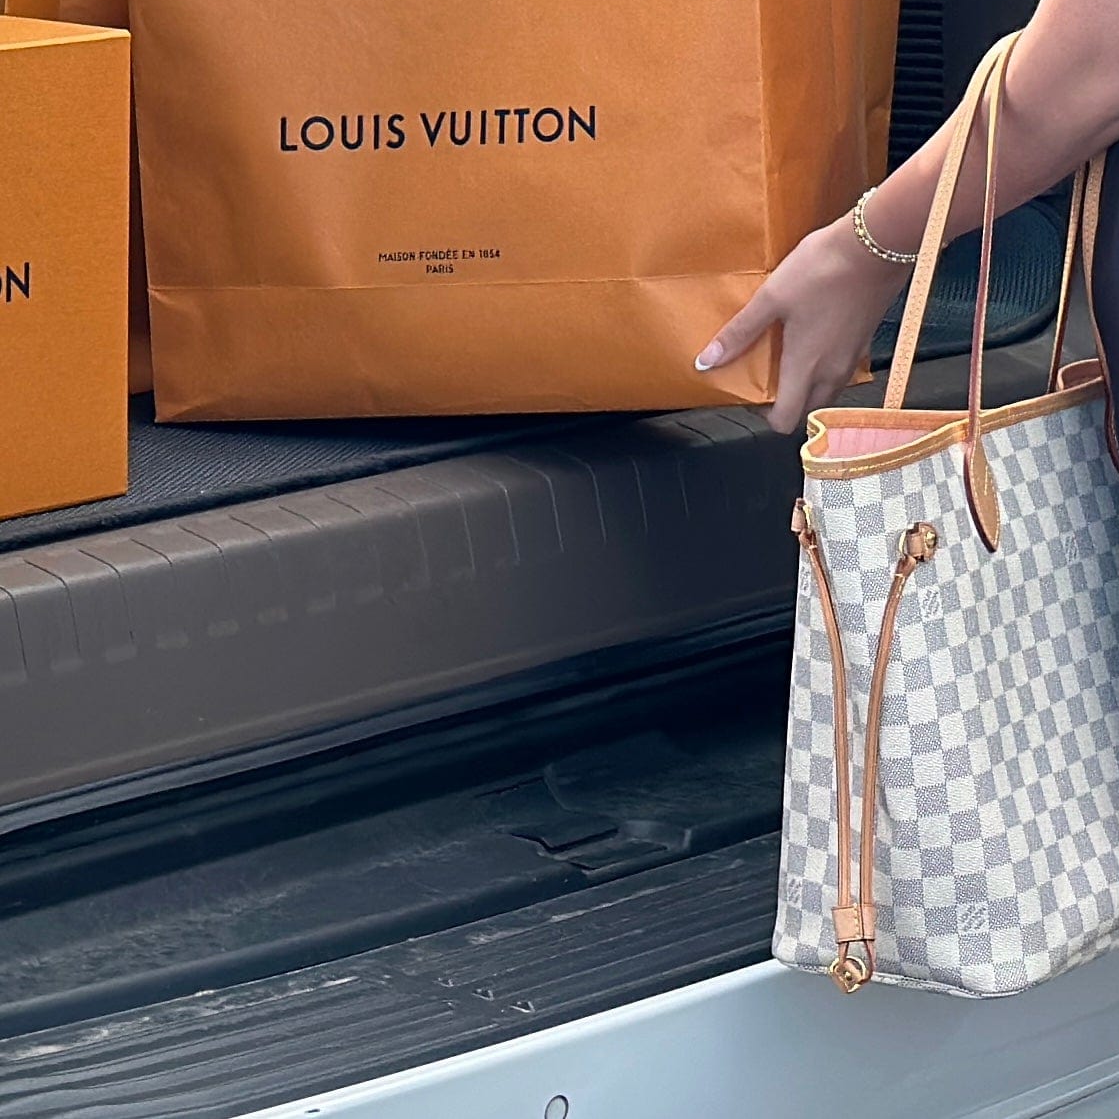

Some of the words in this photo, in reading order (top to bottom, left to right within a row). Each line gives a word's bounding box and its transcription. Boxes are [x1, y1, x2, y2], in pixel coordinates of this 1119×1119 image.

[280, 113, 406, 152] LOUIS
[420, 105, 596, 148] VUITTON
[378, 251, 416, 262] MAISON
[418, 248, 459, 261] FONDÉE
[461, 249, 476, 260] EN
[479, 248, 501, 259] 1854
[425, 263, 454, 274] PARIS
